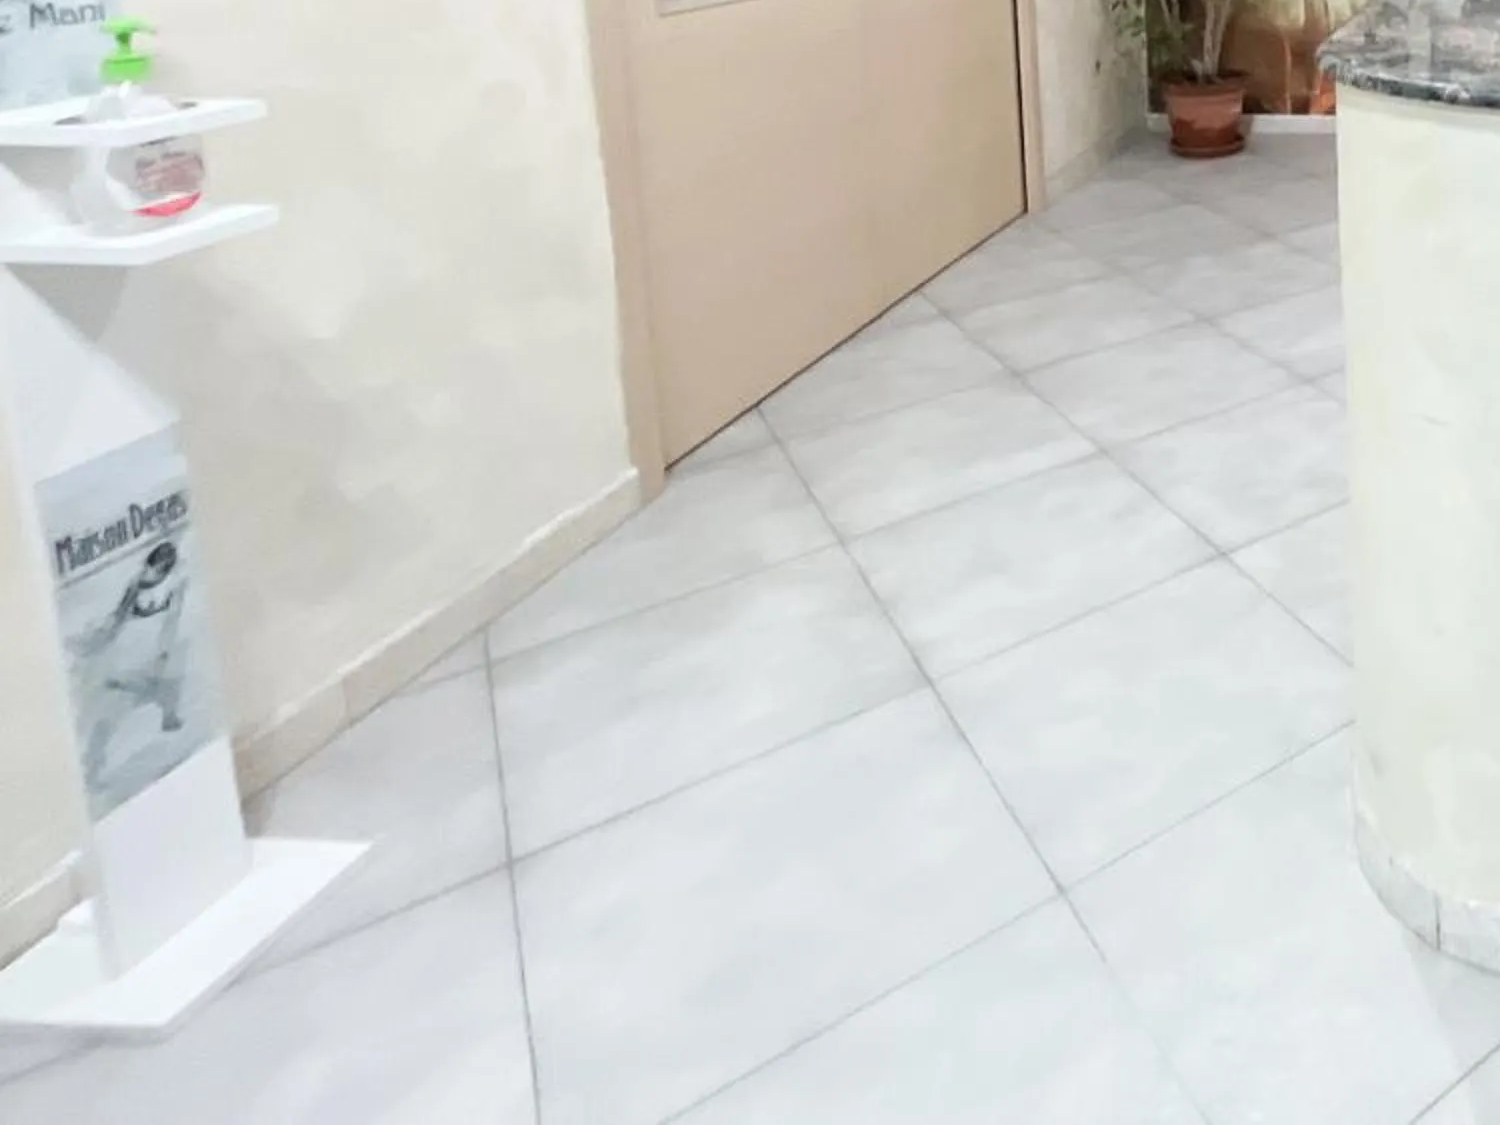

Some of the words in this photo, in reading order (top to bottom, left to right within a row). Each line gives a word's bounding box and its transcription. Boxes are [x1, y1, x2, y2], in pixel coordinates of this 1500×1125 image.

[30, 2, 105, 29] Mani
[55, 517, 128, 575] Maison
[129, 493, 187, 538] Degas
